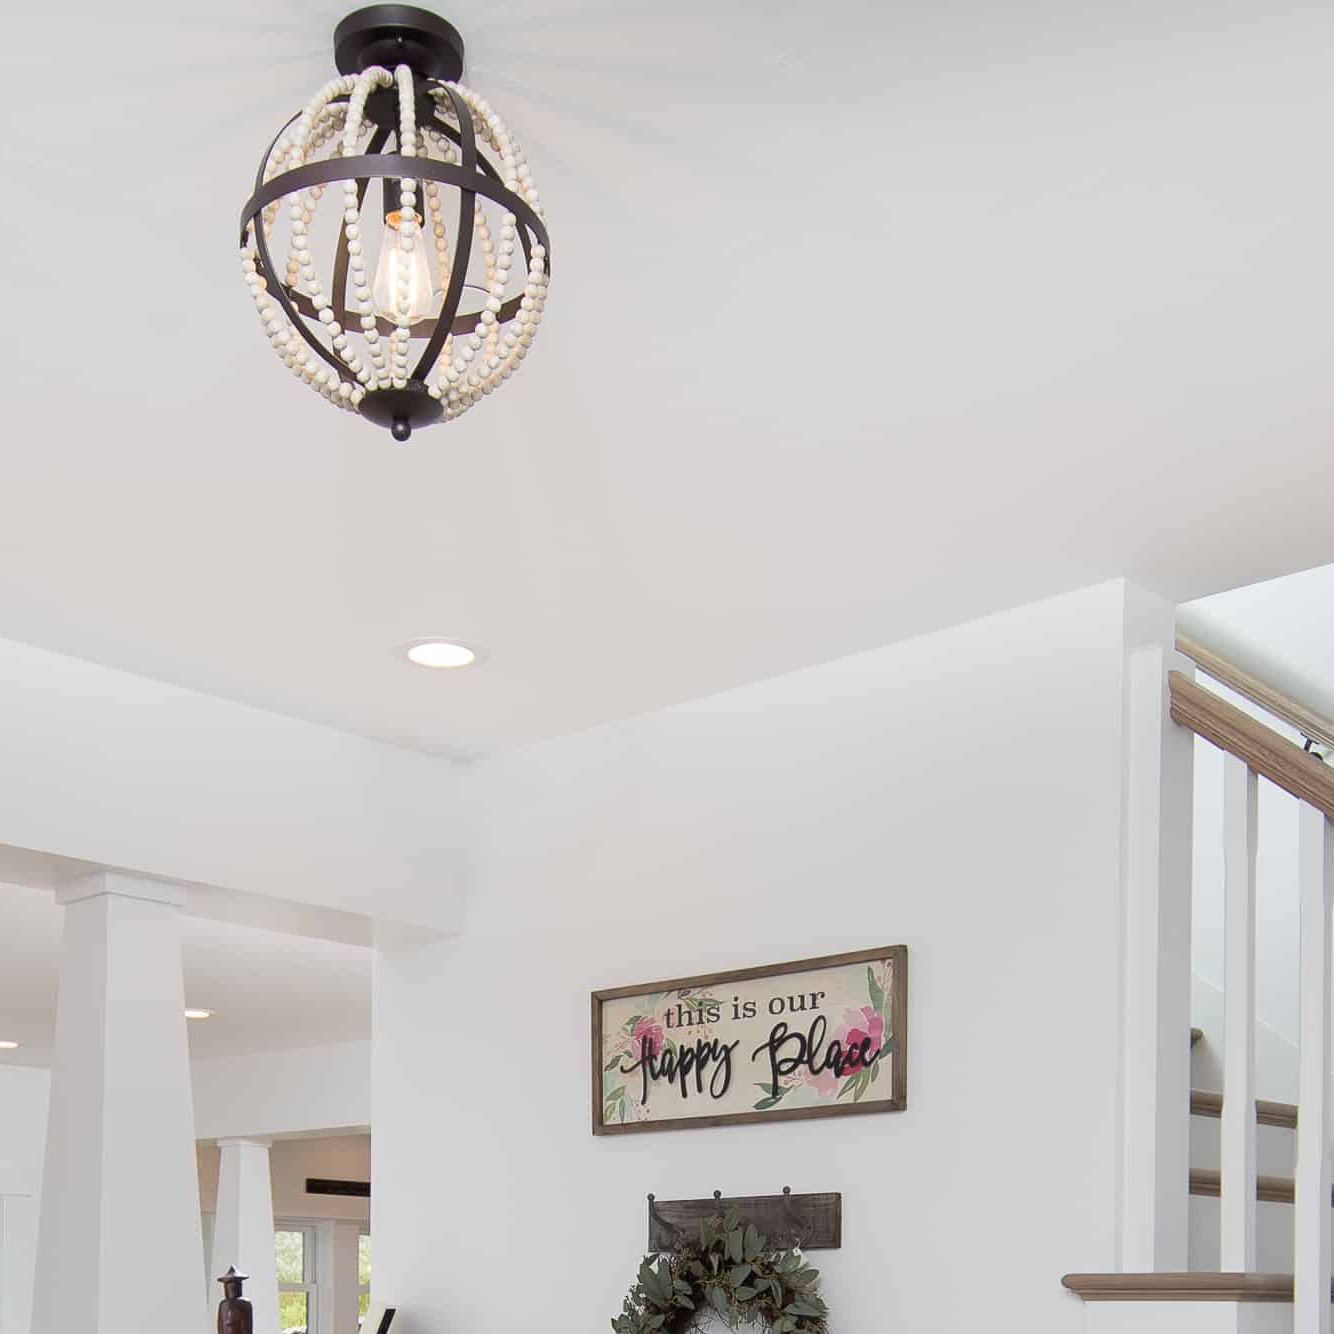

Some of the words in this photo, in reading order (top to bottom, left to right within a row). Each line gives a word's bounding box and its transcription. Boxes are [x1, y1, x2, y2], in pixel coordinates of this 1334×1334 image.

[663, 1003, 721, 1029] this
[730, 996, 757, 1020] is
[768, 991, 826, 1015] our
[620, 1033, 740, 1105] Happy
[751, 1015, 881, 1098] Place
